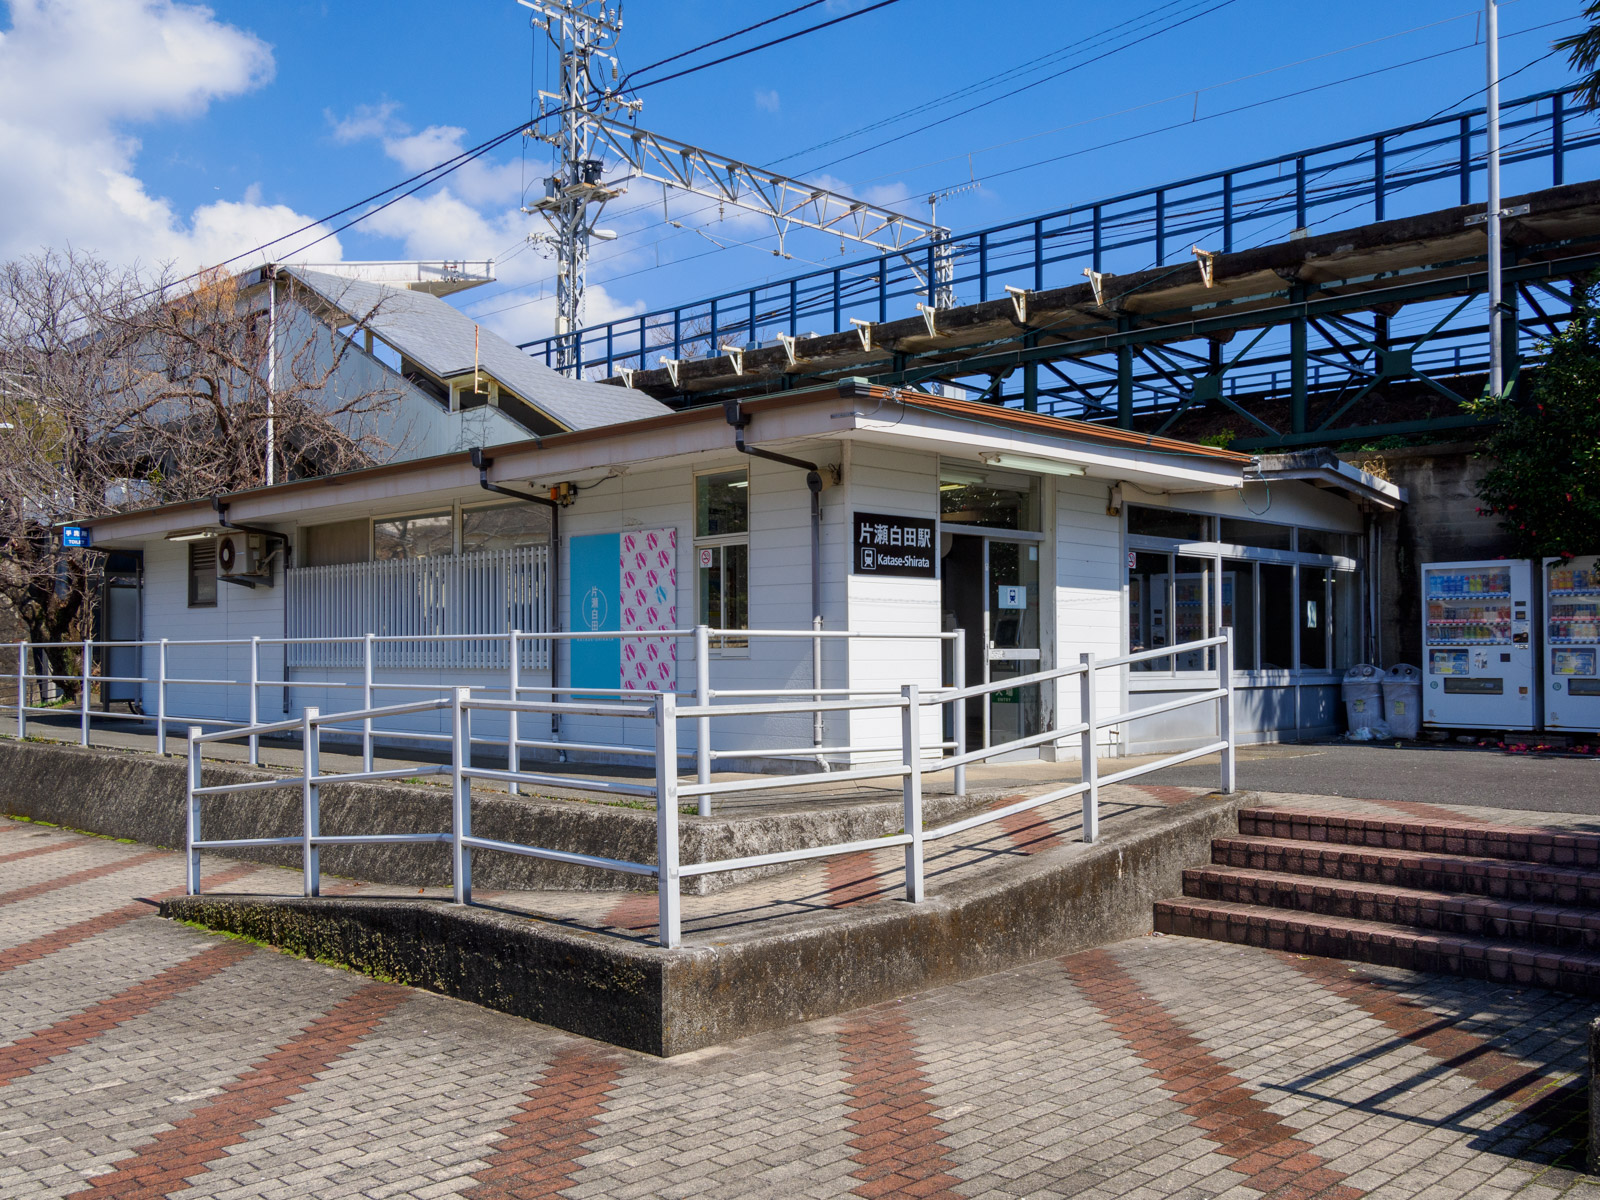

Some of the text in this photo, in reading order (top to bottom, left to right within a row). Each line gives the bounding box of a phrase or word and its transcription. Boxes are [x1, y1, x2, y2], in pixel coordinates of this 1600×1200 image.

[859, 522, 931, 548] 片瀬白田駅
[877, 553, 930, 568] Katase-Shirata
